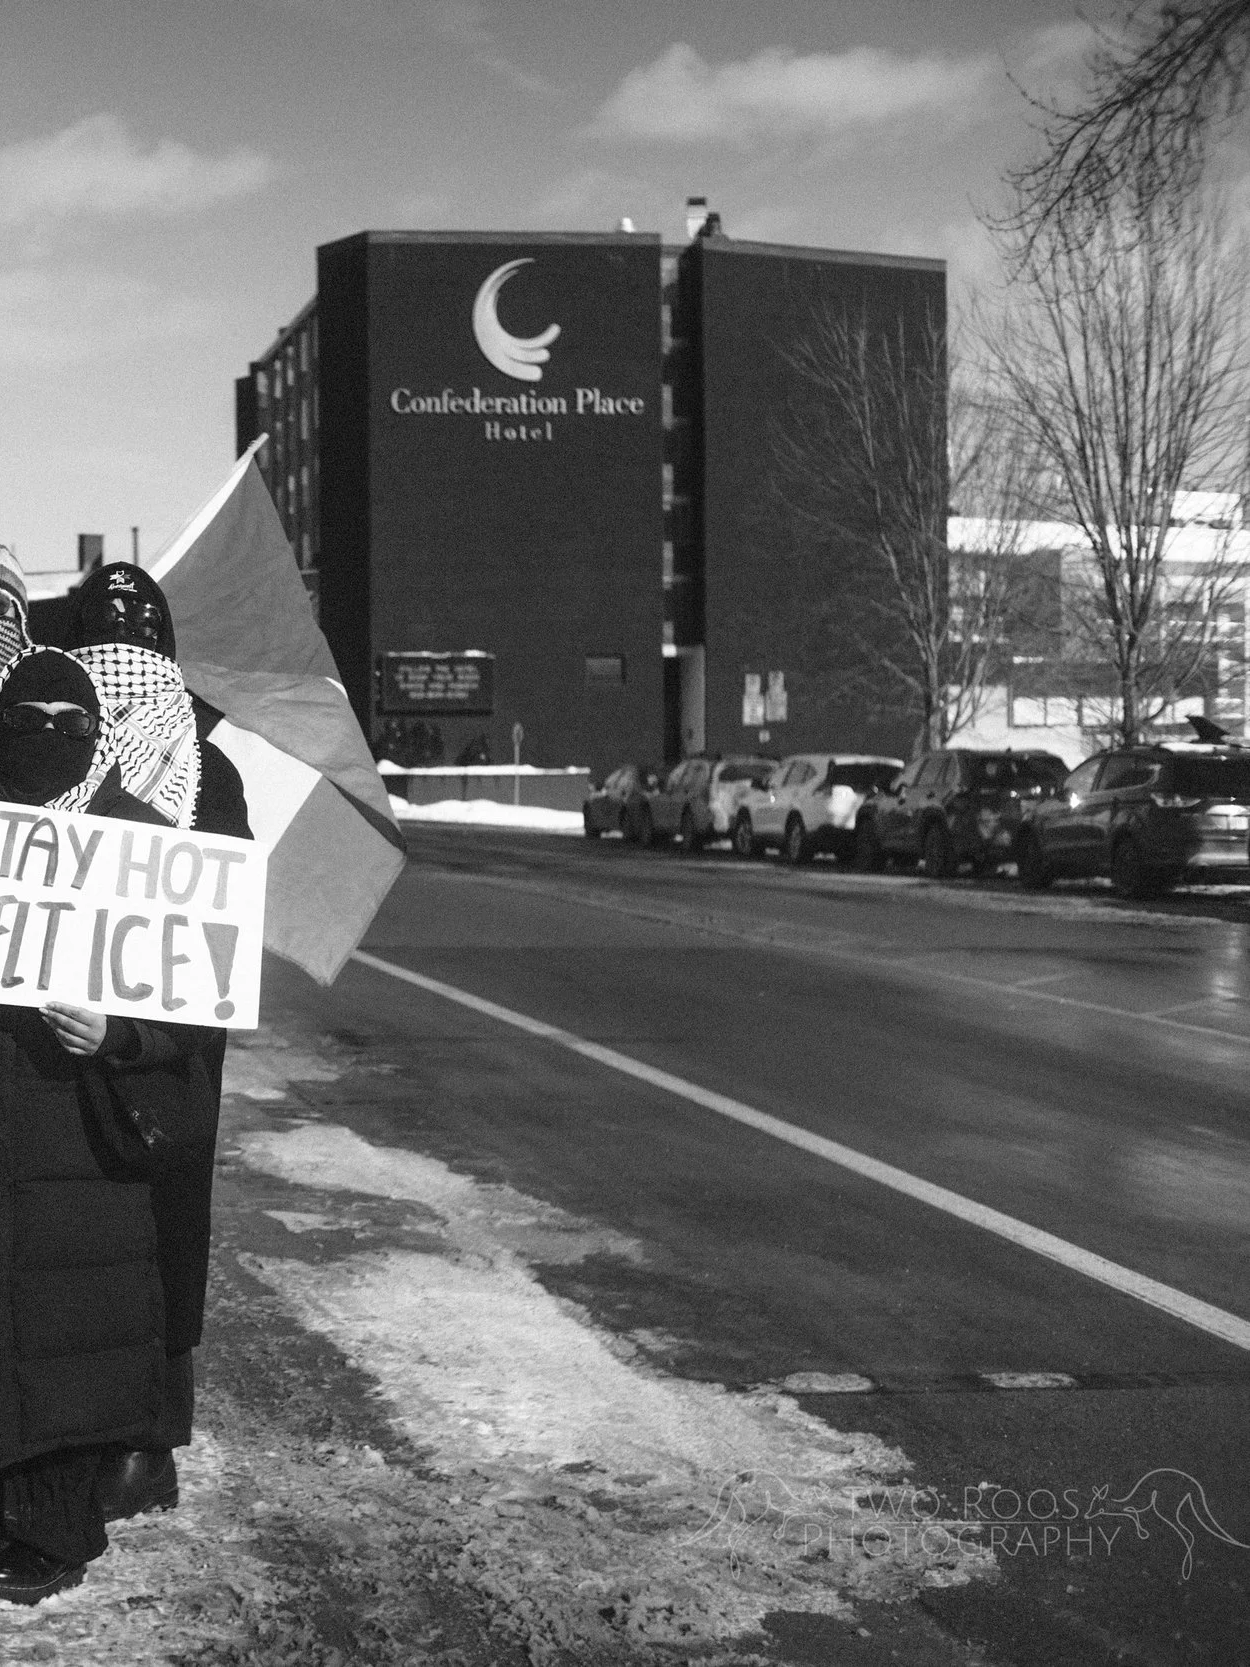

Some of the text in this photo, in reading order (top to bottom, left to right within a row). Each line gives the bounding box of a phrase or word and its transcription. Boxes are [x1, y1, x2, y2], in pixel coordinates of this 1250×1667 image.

[390, 386, 645, 415] Confederation Place
[484, 420, 553, 441] Hotel
[116, 829, 247, 910] HOT
[87, 908, 240, 1021] ICE!
